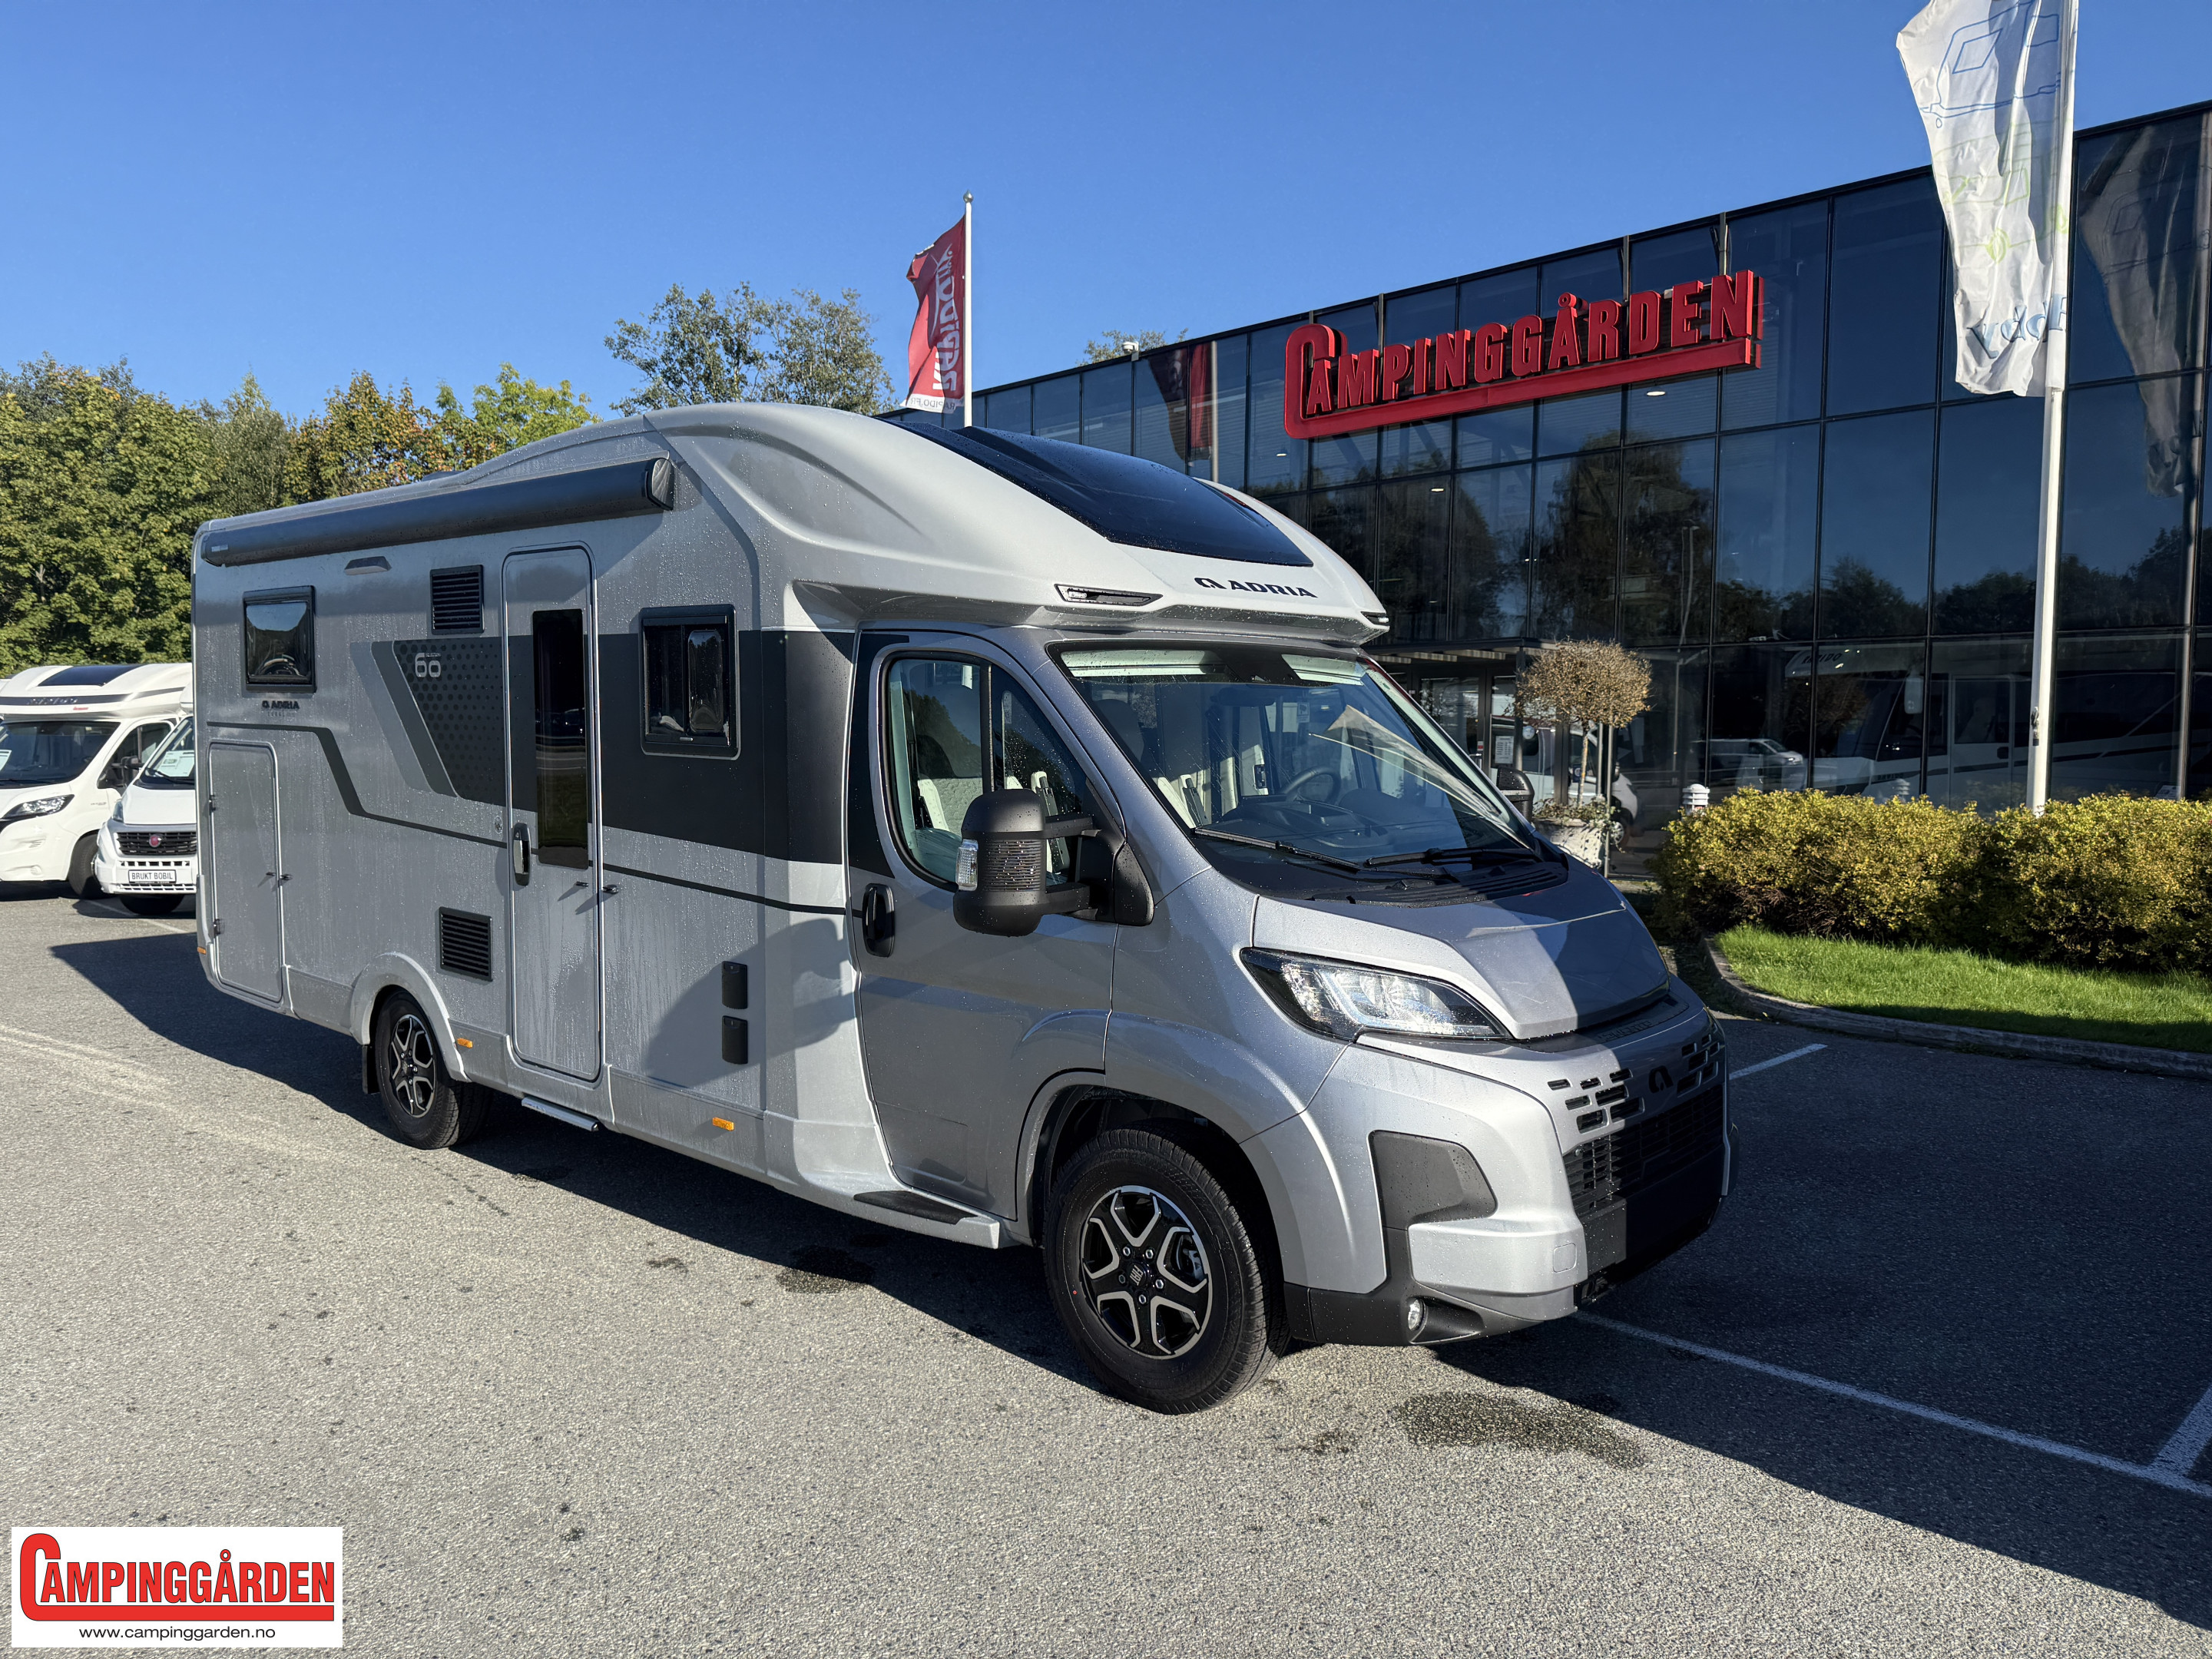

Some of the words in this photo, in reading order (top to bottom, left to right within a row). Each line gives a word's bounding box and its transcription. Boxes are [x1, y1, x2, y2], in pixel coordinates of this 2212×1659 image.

[1284, 269, 1762, 439] CAMPINGGÅRDEN
[1227, 580, 1318, 598] ADRIA
[415, 652, 442, 677] 60
[131, 872, 152, 880] BRUKT
[1129, 1264, 1144, 1286] FIAT
